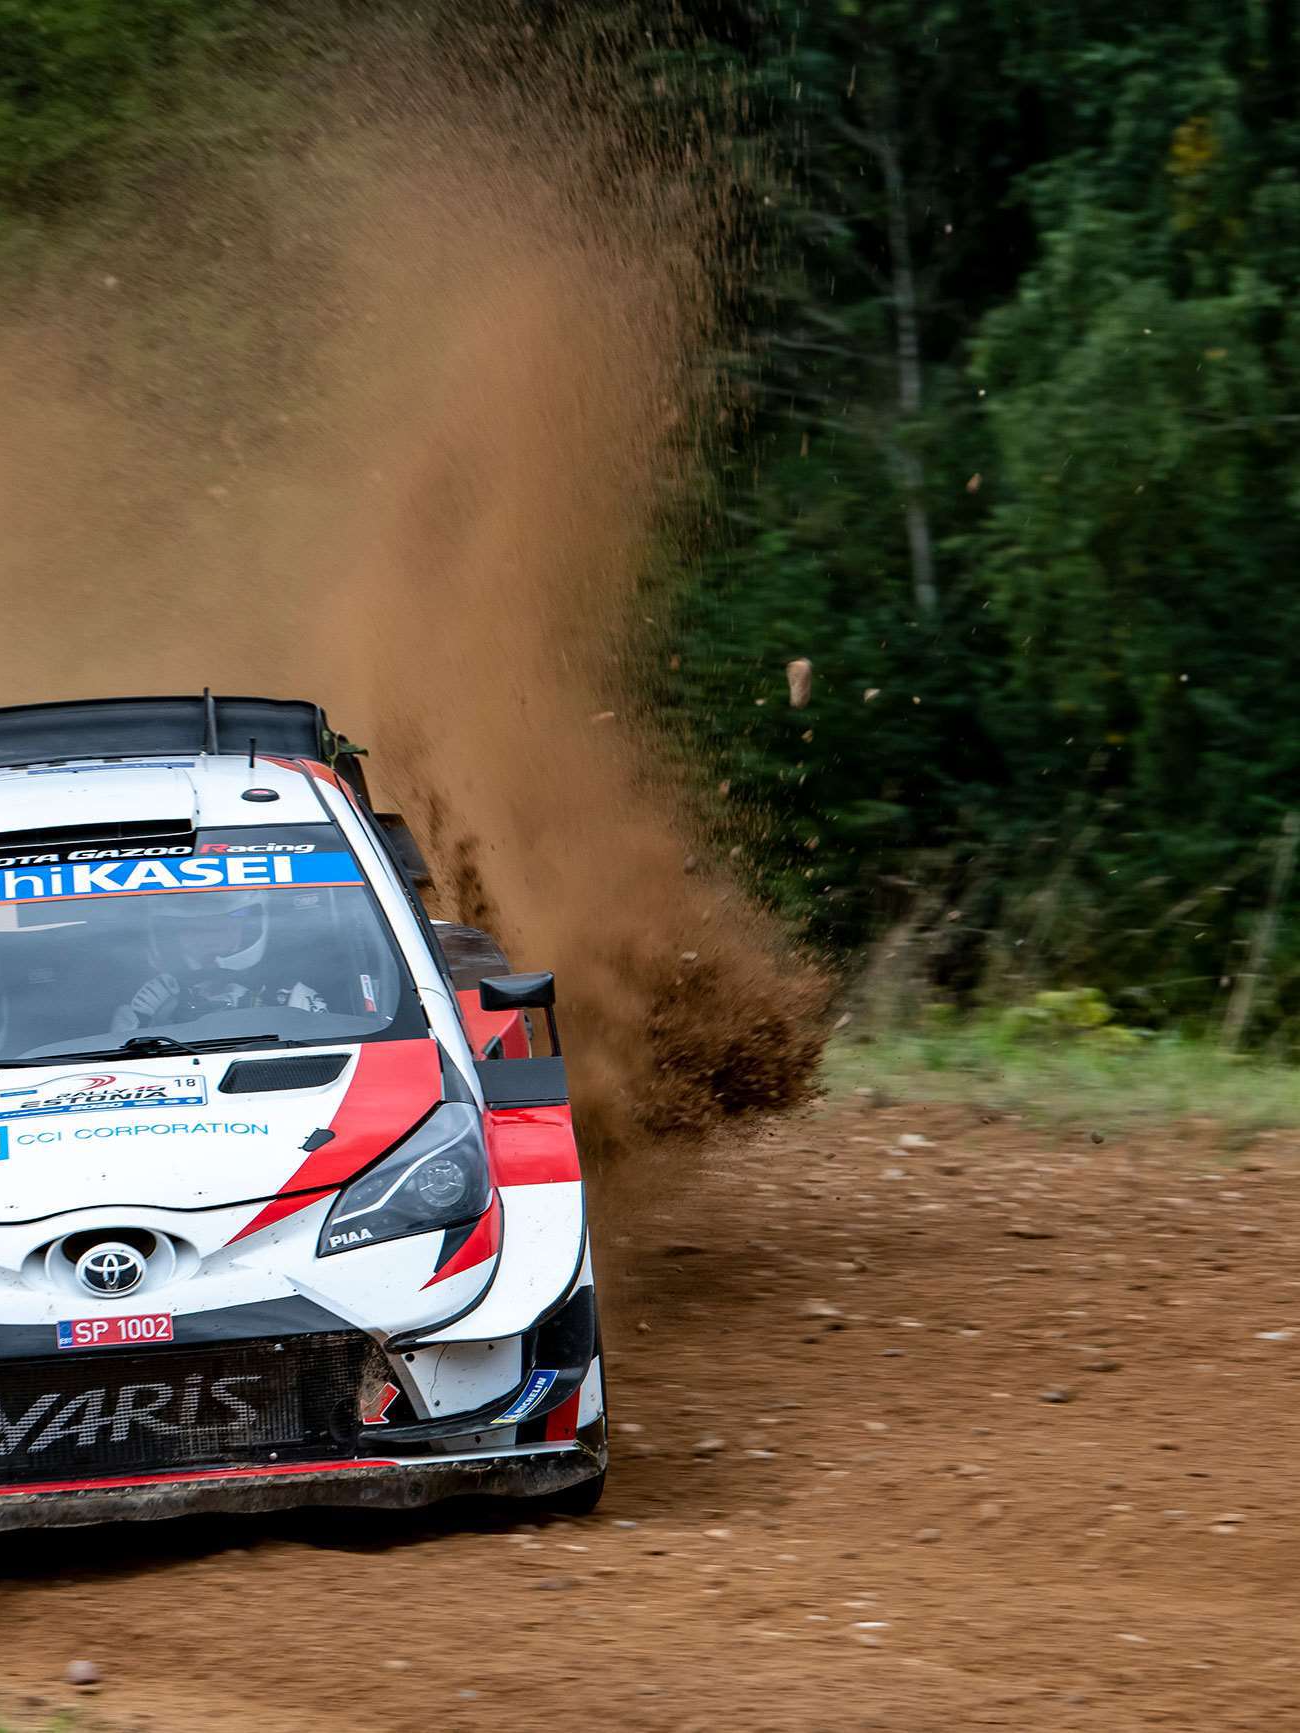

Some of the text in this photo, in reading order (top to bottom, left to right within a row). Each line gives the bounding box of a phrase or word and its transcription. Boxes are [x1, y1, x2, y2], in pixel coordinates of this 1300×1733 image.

[67, 846, 193, 861] GAZOO
[201, 842, 316, 854] Racing
[173, 1078, 196, 1087] 18
[20, 1091, 169, 1109] ESTONIA
[56, 1089, 129, 1099] RALLY
[17, 1122, 269, 1145] CCI CORPORATION
[329, 1228, 373, 1248] PIAA
[75, 1317, 170, 1343] SP 1002
[512, 1377, 548, 1416] MICHELIN
